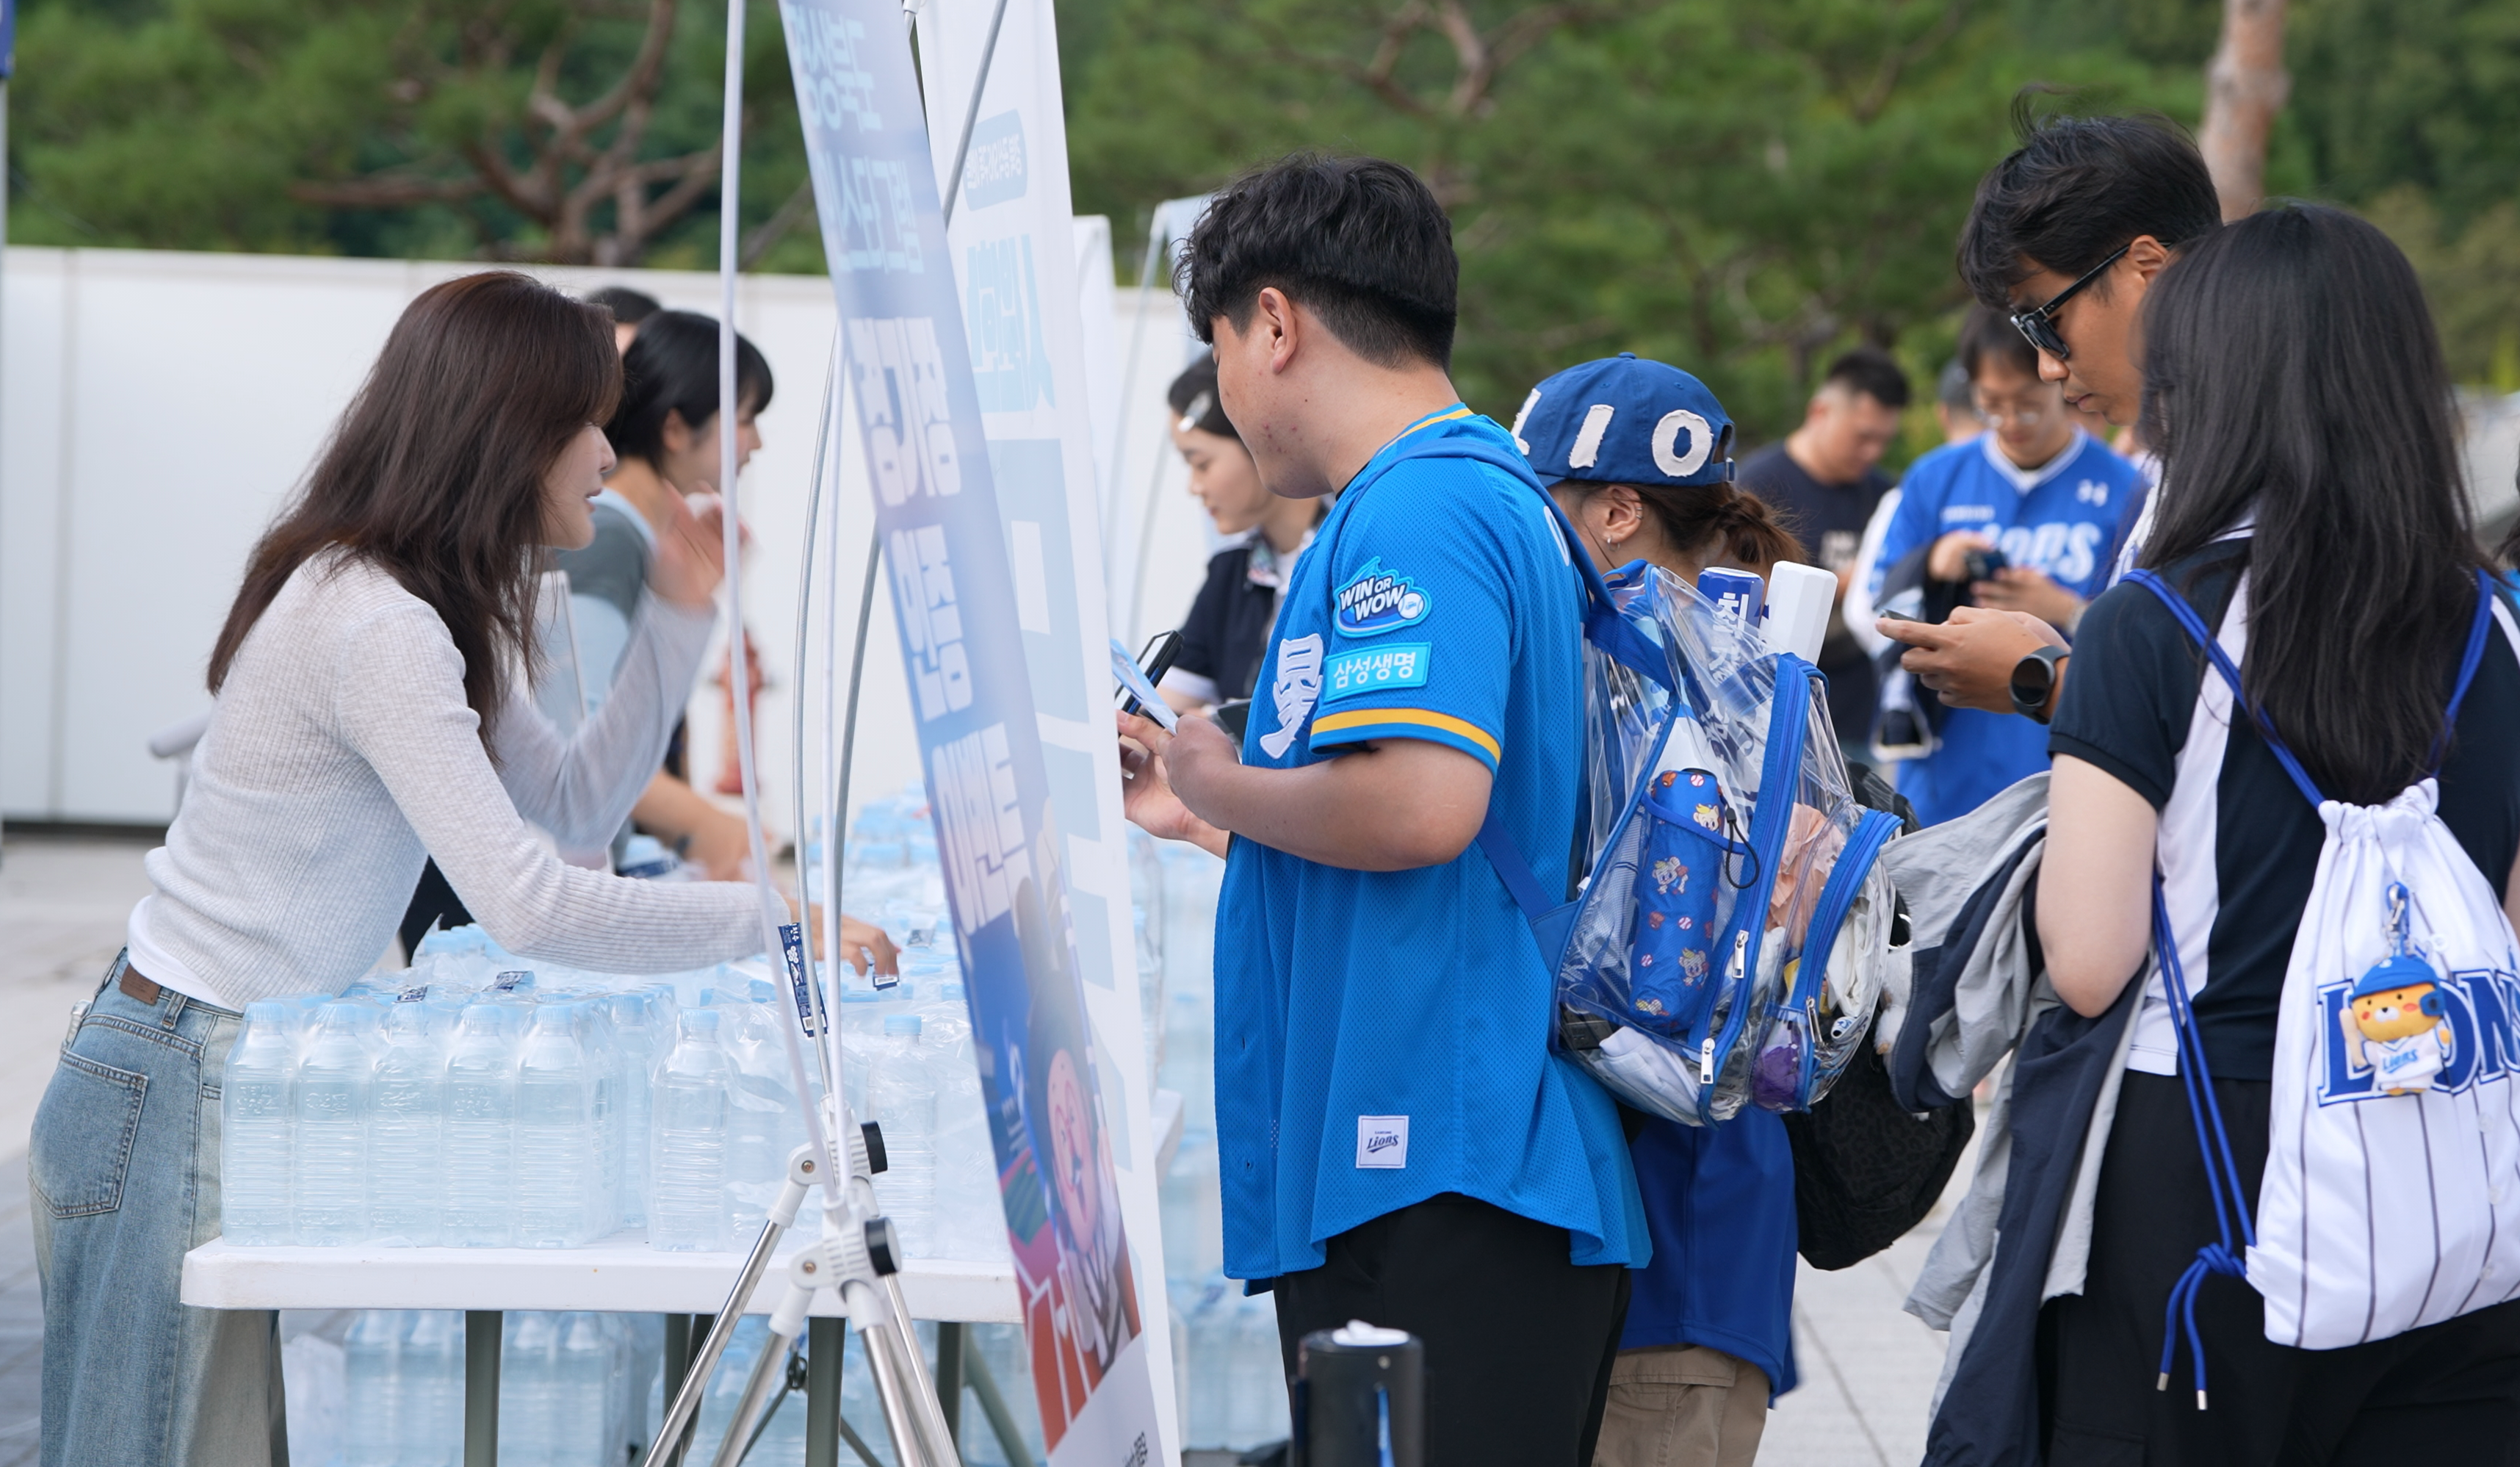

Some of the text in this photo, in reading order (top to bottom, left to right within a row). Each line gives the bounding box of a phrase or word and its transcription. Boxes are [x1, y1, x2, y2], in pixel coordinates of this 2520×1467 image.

[1339, 577, 1393, 610] WIN OR
[1354, 585, 1406, 621] WOW
[1334, 652, 1416, 689] 삼성생명
[931, 721, 1036, 936] 이벤트
[1367, 1134, 1399, 1150] Lions
